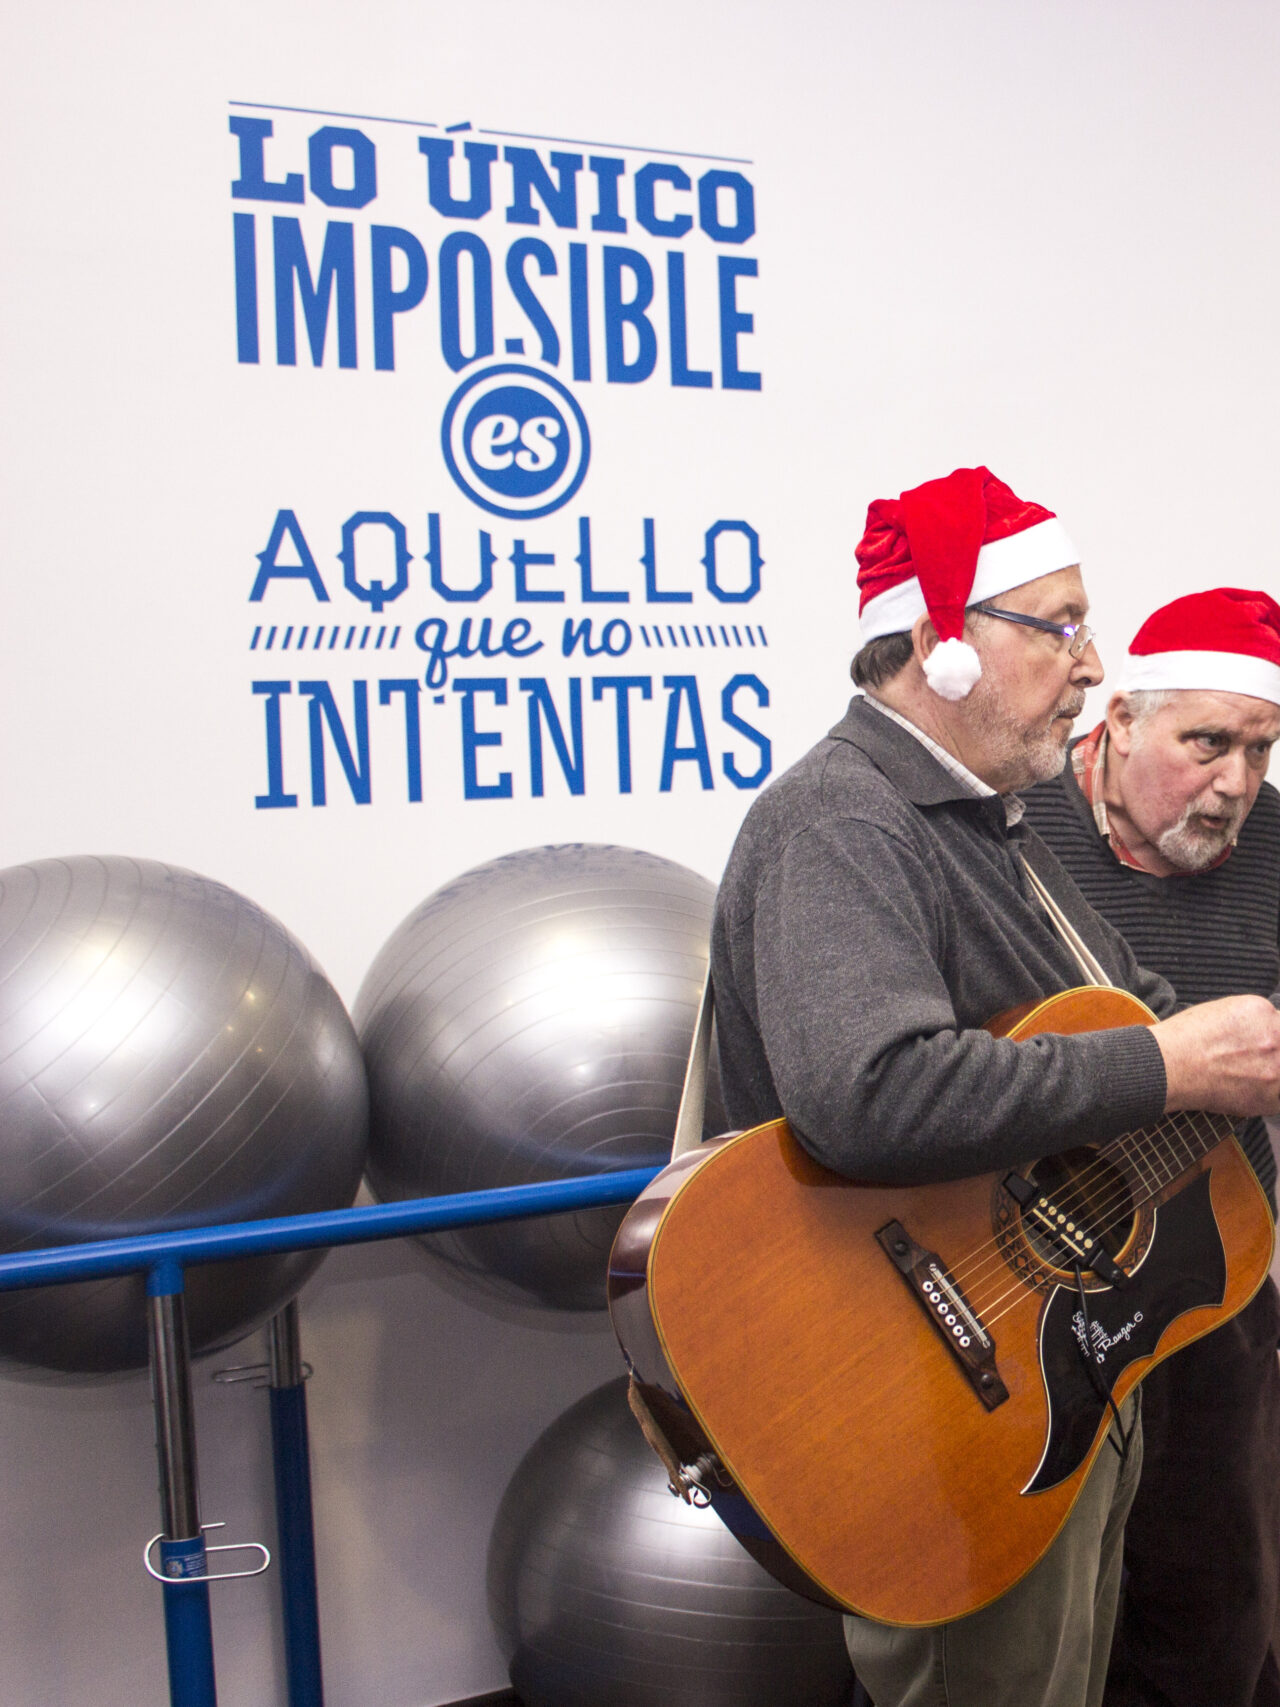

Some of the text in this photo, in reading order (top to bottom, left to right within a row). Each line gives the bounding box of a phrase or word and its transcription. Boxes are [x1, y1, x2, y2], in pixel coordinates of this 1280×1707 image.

[228, 114, 757, 246] LO ÚNICO
[231, 211, 763, 392] IMPOSIBLE
[471, 414, 561, 473] es
[248, 508, 766, 614] AQUELLO
[414, 617, 633, 690] que no
[250, 673, 773, 810] INTENTAS
[1097, 1311, 1144, 1352] Ranger 6
